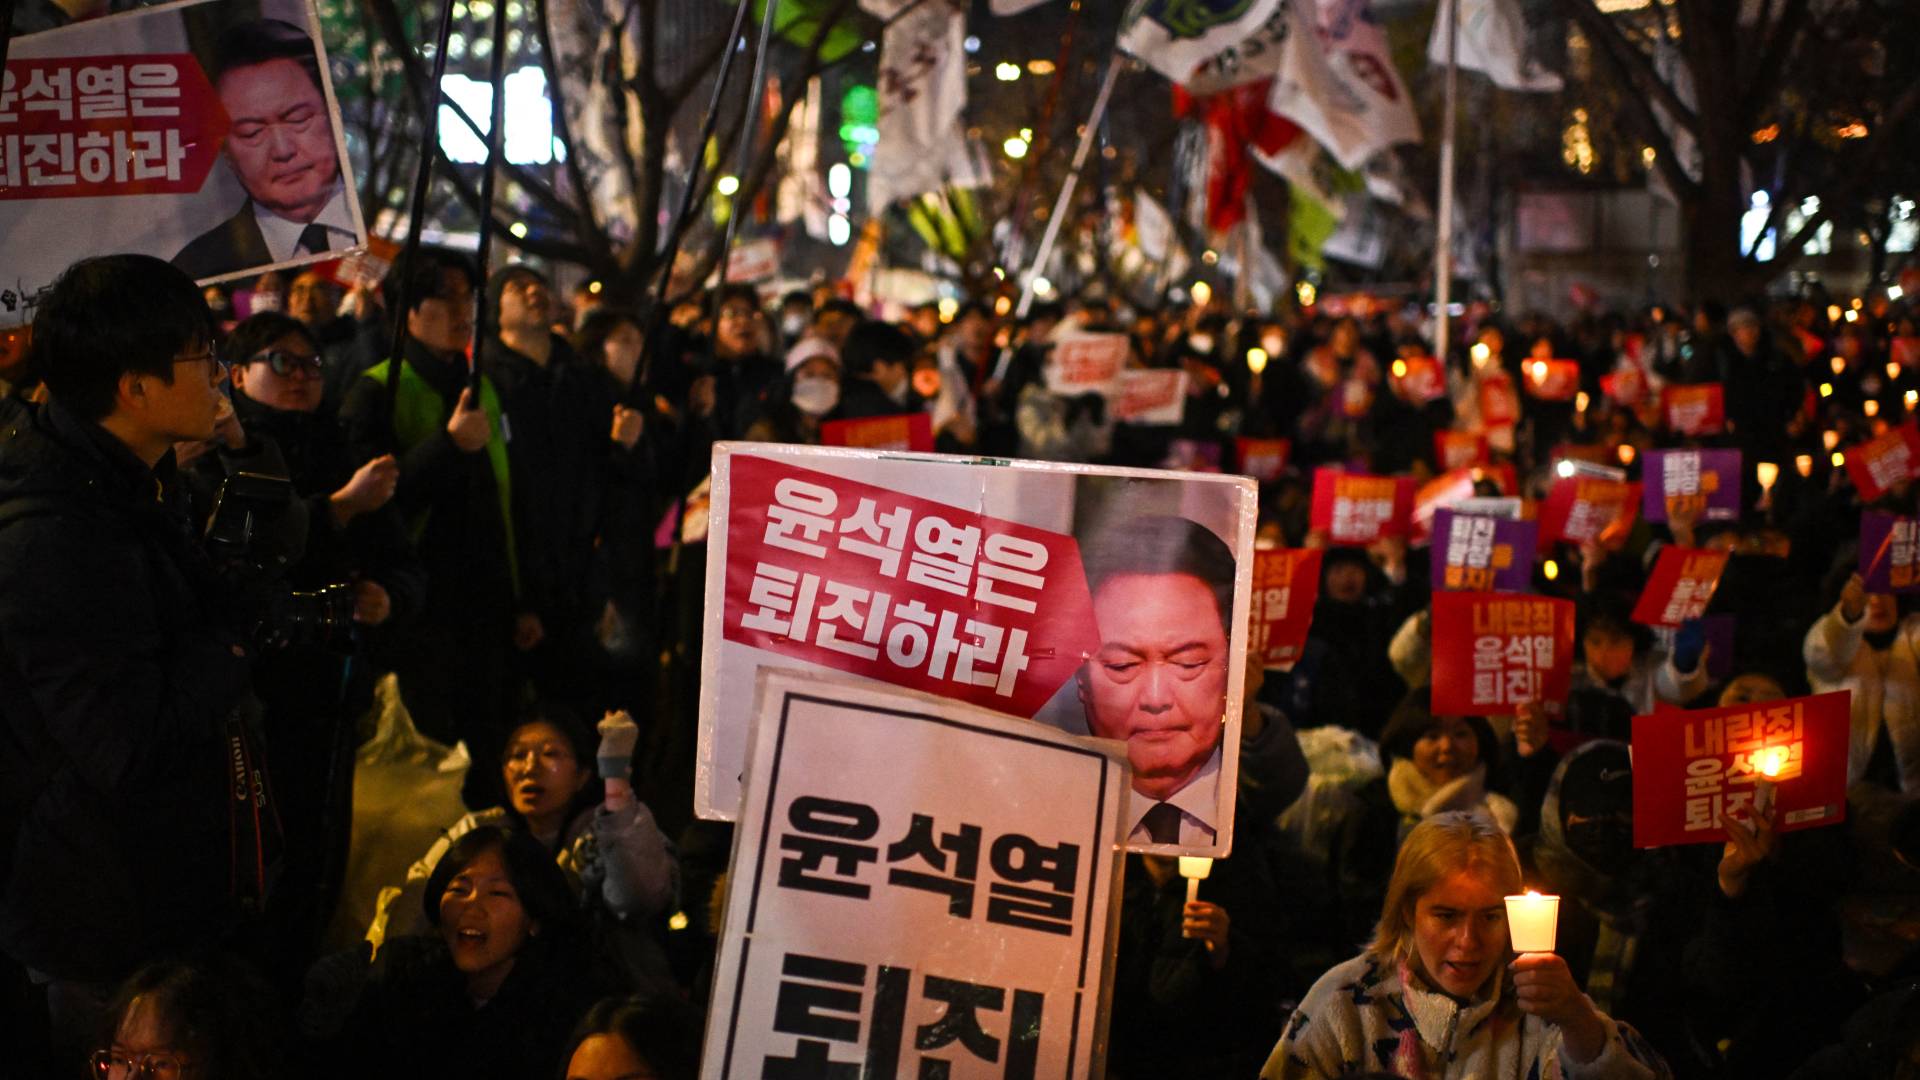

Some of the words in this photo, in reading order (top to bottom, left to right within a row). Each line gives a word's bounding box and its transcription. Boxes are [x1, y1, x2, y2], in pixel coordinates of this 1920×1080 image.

[763, 477, 1049, 614] 윤석열은
[740, 561, 1029, 698] 퇴진하라
[1473, 601, 1554, 635] 내란죄
[1474, 635, 1554, 670] 윤석열
[233, 737, 247, 800] Canon
[1684, 702, 1804, 758] 내란죄
[778, 795, 1080, 937] 윤석열
[760, 952, 1046, 1080] 퇴진
